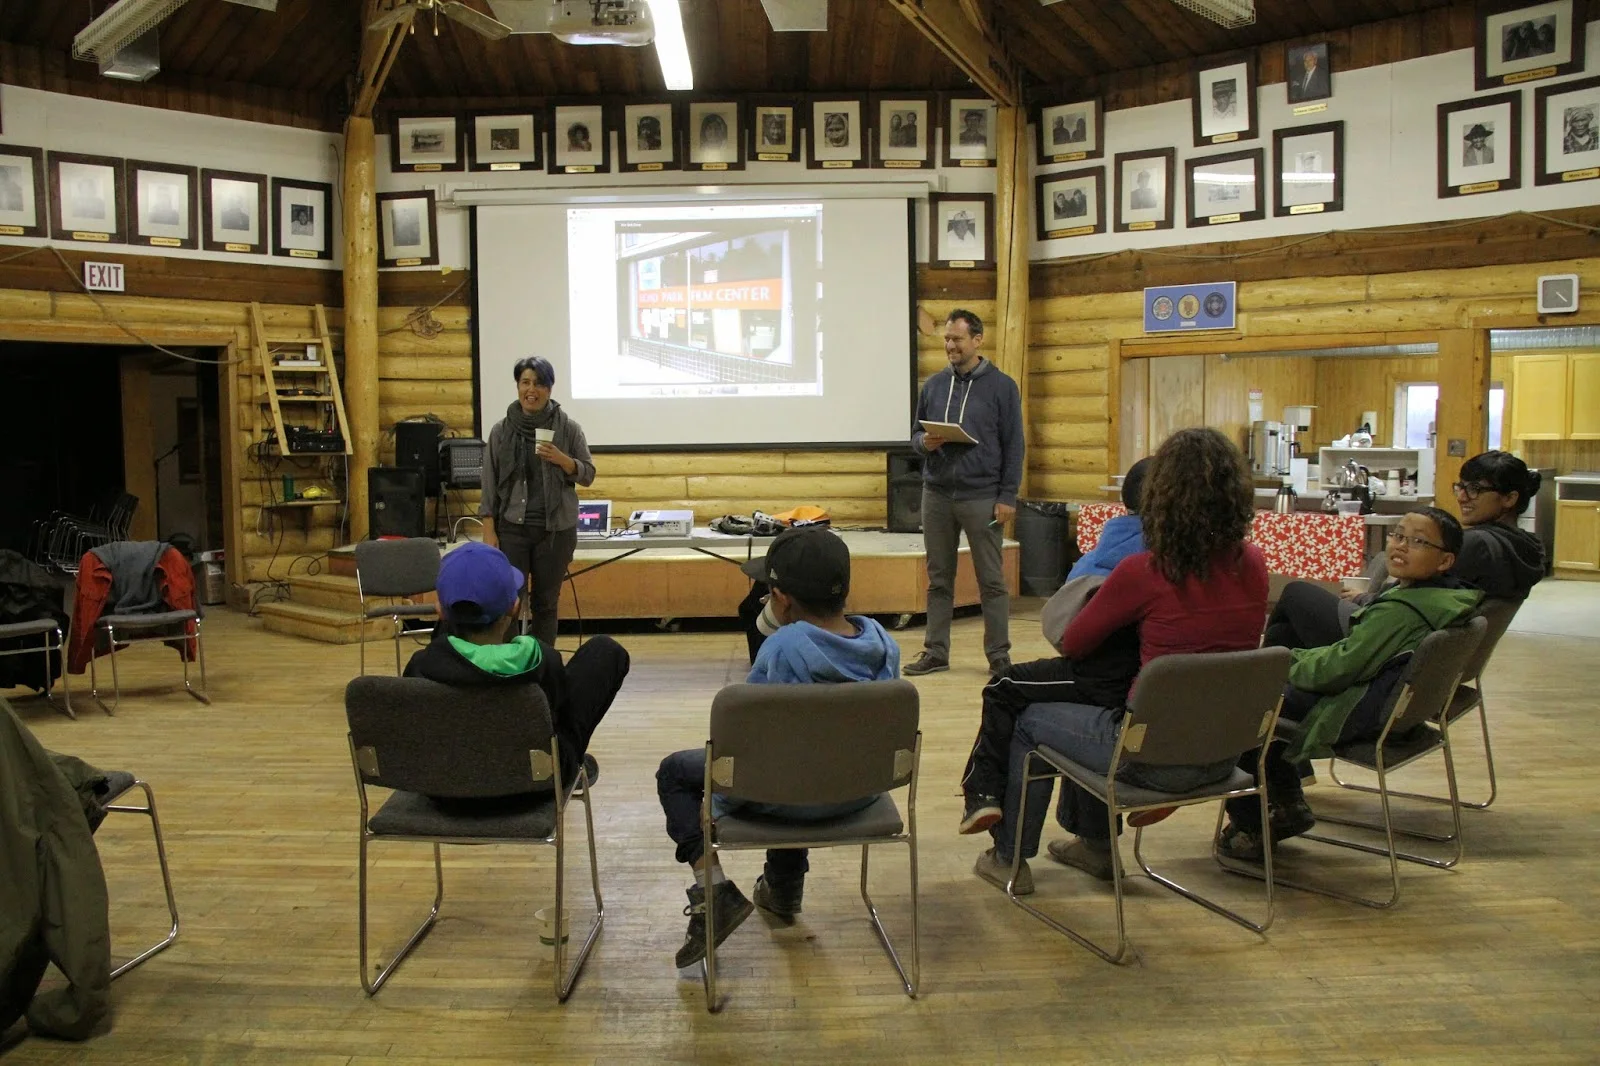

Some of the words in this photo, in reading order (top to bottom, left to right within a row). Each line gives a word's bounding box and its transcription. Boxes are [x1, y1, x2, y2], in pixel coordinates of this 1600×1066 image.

[89, 265, 121, 288] EXIT
[690, 288, 714, 302] FILM
[716, 286, 771, 301] CENTER
